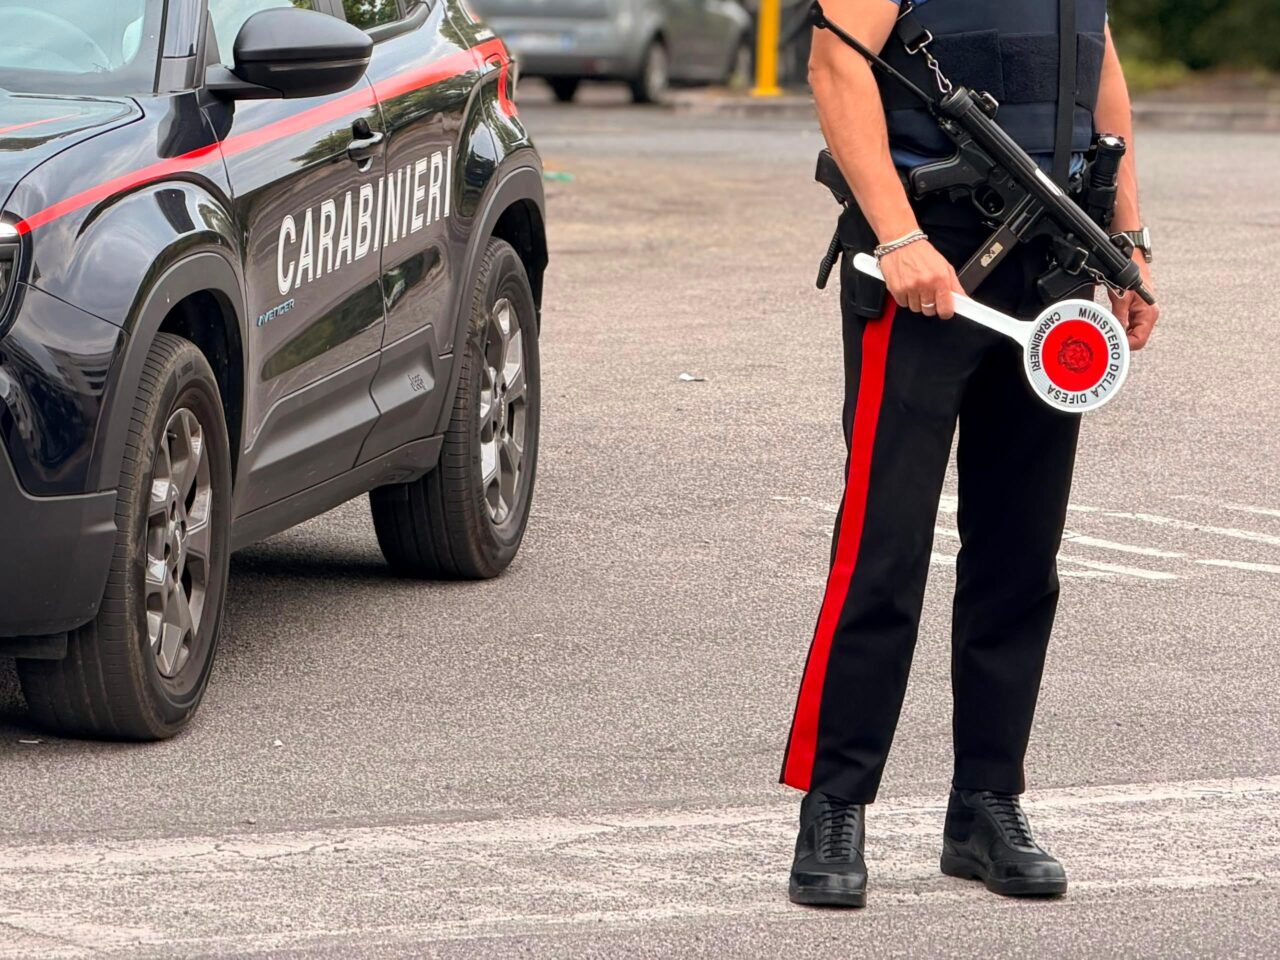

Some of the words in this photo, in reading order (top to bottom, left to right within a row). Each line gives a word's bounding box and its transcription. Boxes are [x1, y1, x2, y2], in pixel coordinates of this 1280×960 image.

[277, 146, 452, 295] CARABINIERI
[1030, 311, 1061, 371] CARABINIERI
[1078, 307, 1120, 361] MINISTERO
[1048, 384, 1087, 404] DIFESA
[1091, 363, 1119, 397] DELLA
